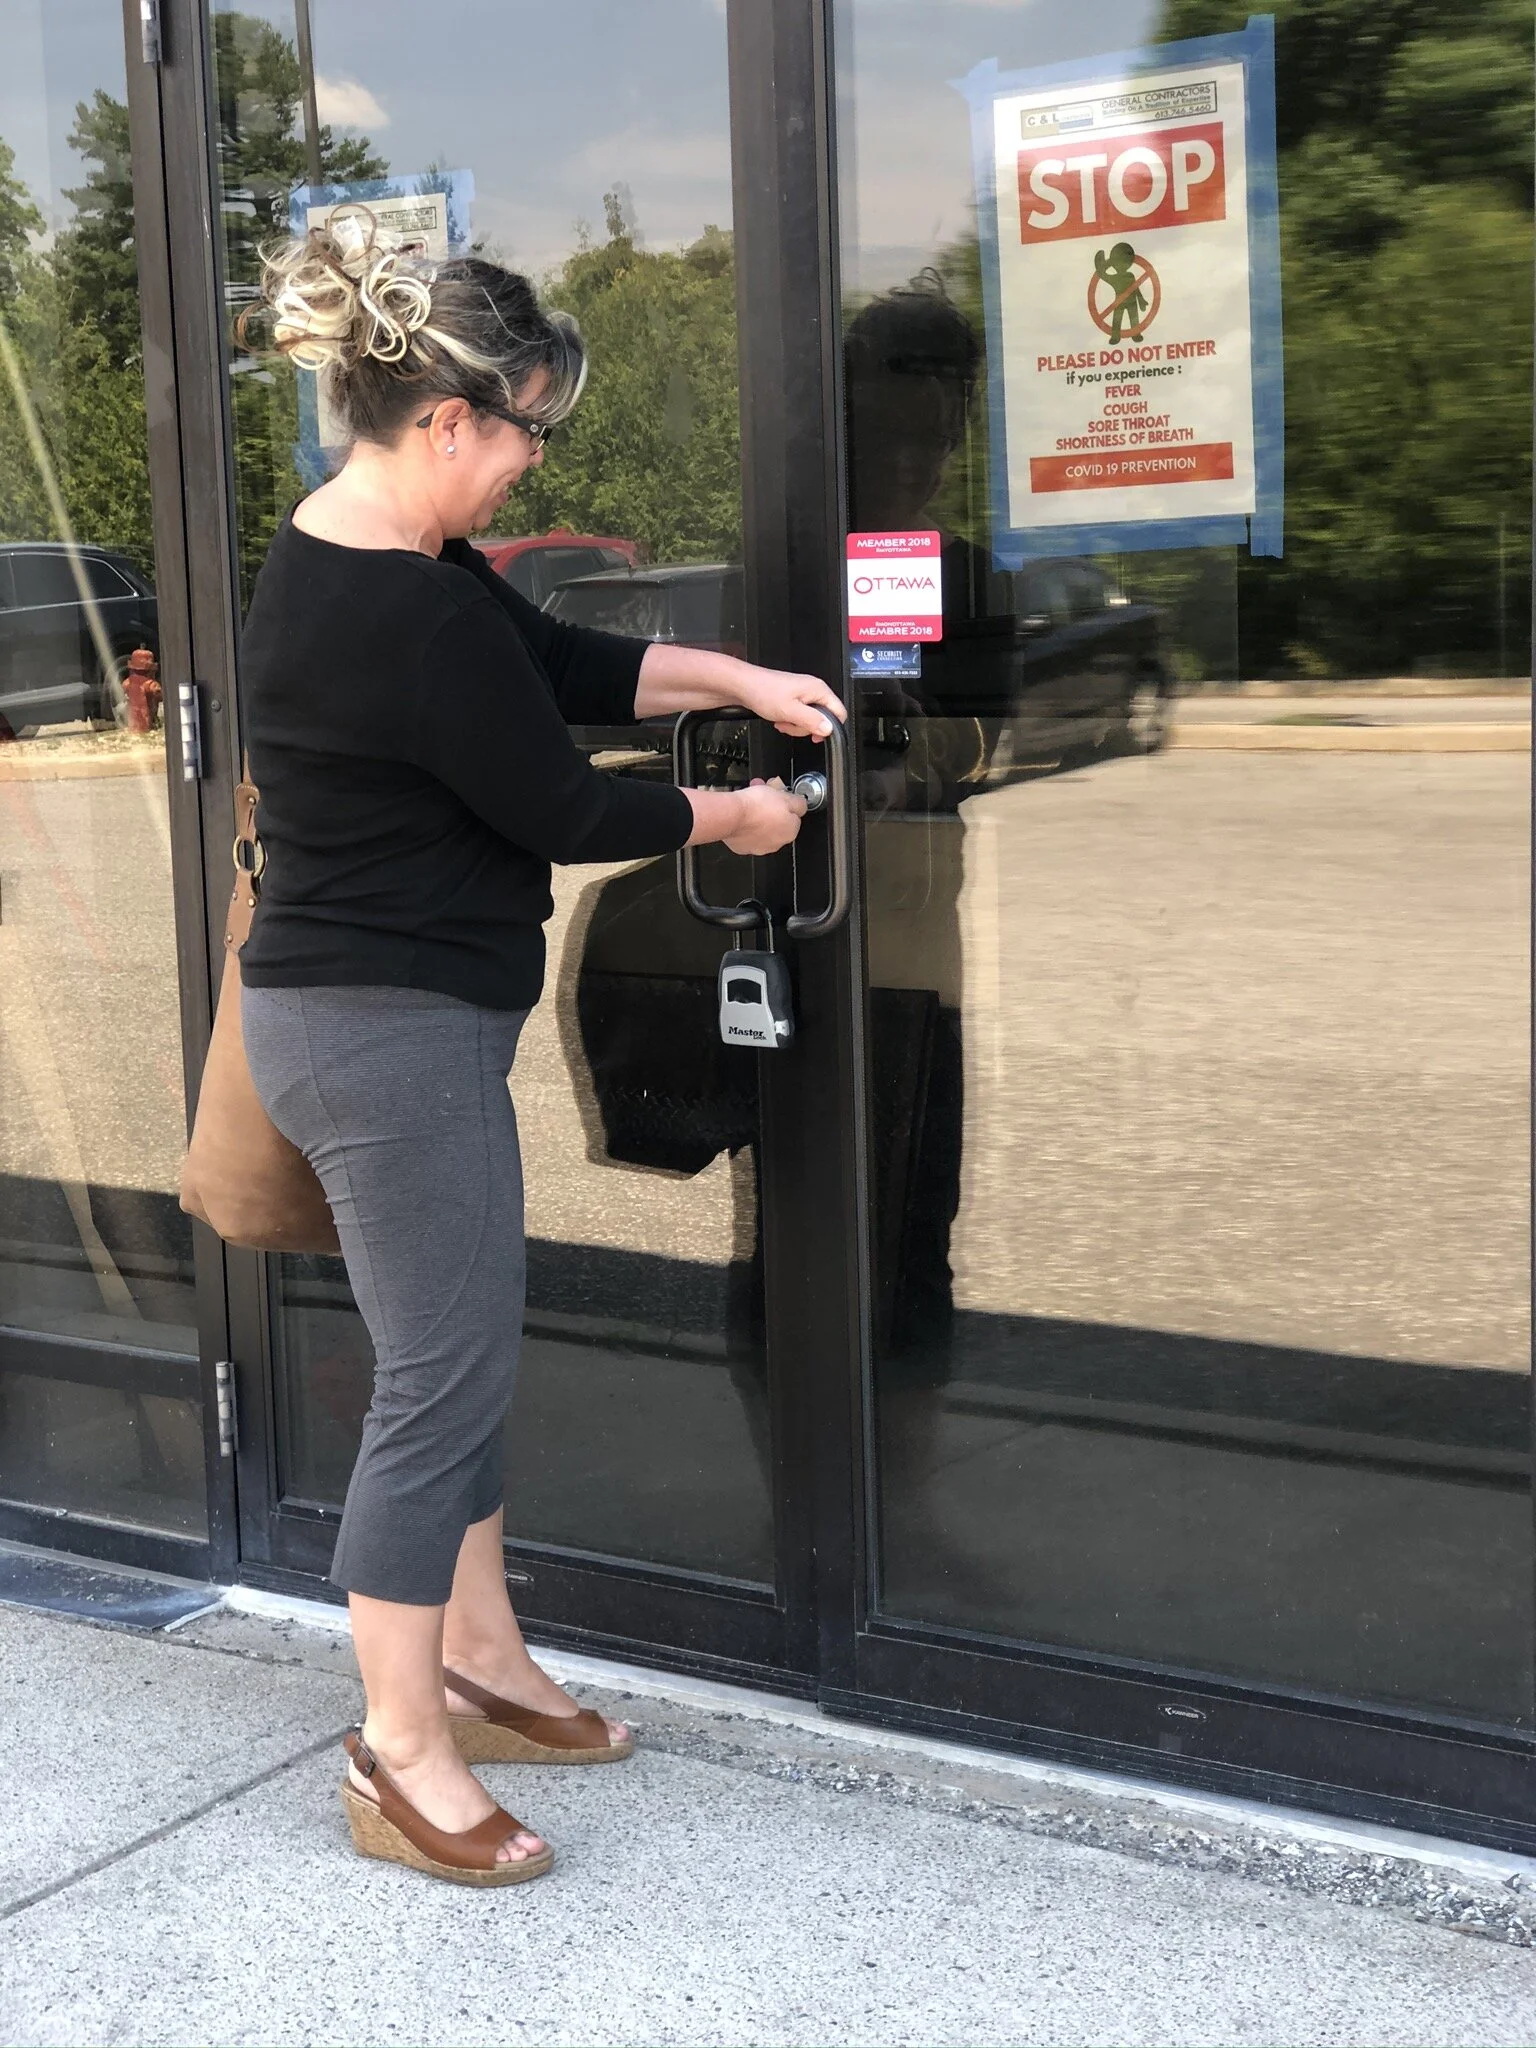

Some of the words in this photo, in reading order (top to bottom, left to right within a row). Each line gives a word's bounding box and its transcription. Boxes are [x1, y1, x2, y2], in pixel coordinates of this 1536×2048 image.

[1102, 96, 1141, 109] GENERAL
[1145, 84, 1211, 103] CONTRACTORS
[1027, 115, 1036, 126] C
[1040, 114, 1048, 125] &
[1052, 113, 1060, 123] L
[1027, 139, 1216, 229] STOP
[1037, 352, 1095, 372] PLEASE
[1100, 349, 1124, 366] DO
[1128, 345, 1162, 363] NOT
[1167, 340, 1216, 359] ENTER
[1066, 372, 1075, 385] if
[1078, 372, 1101, 387] you
[1105, 365, 1175, 384] experience
[1105, 384, 1141, 399] FEVER
[1103, 401, 1148, 416] COUGH
[1088, 420, 1119, 433] SORE
[1122, 415, 1170, 431] THROAT
[1056, 434, 1126, 451] SHORTNESS
[1129, 432, 1146, 445] OF
[1148, 428, 1194, 444] BREATH
[1065, 464, 1103, 478] COVID
[1106, 462, 1118, 475] 19
[1121, 457, 1197, 474] PREVENTION
[857, 538, 906, 547] MEMBER
[908, 537, 931, 546] 2018
[854, 577, 935, 594] OTTAWA
[859, 627, 909, 636] MEMBRE
[910, 626, 933, 635] 2018
[728, 1026, 764, 1036] Master
